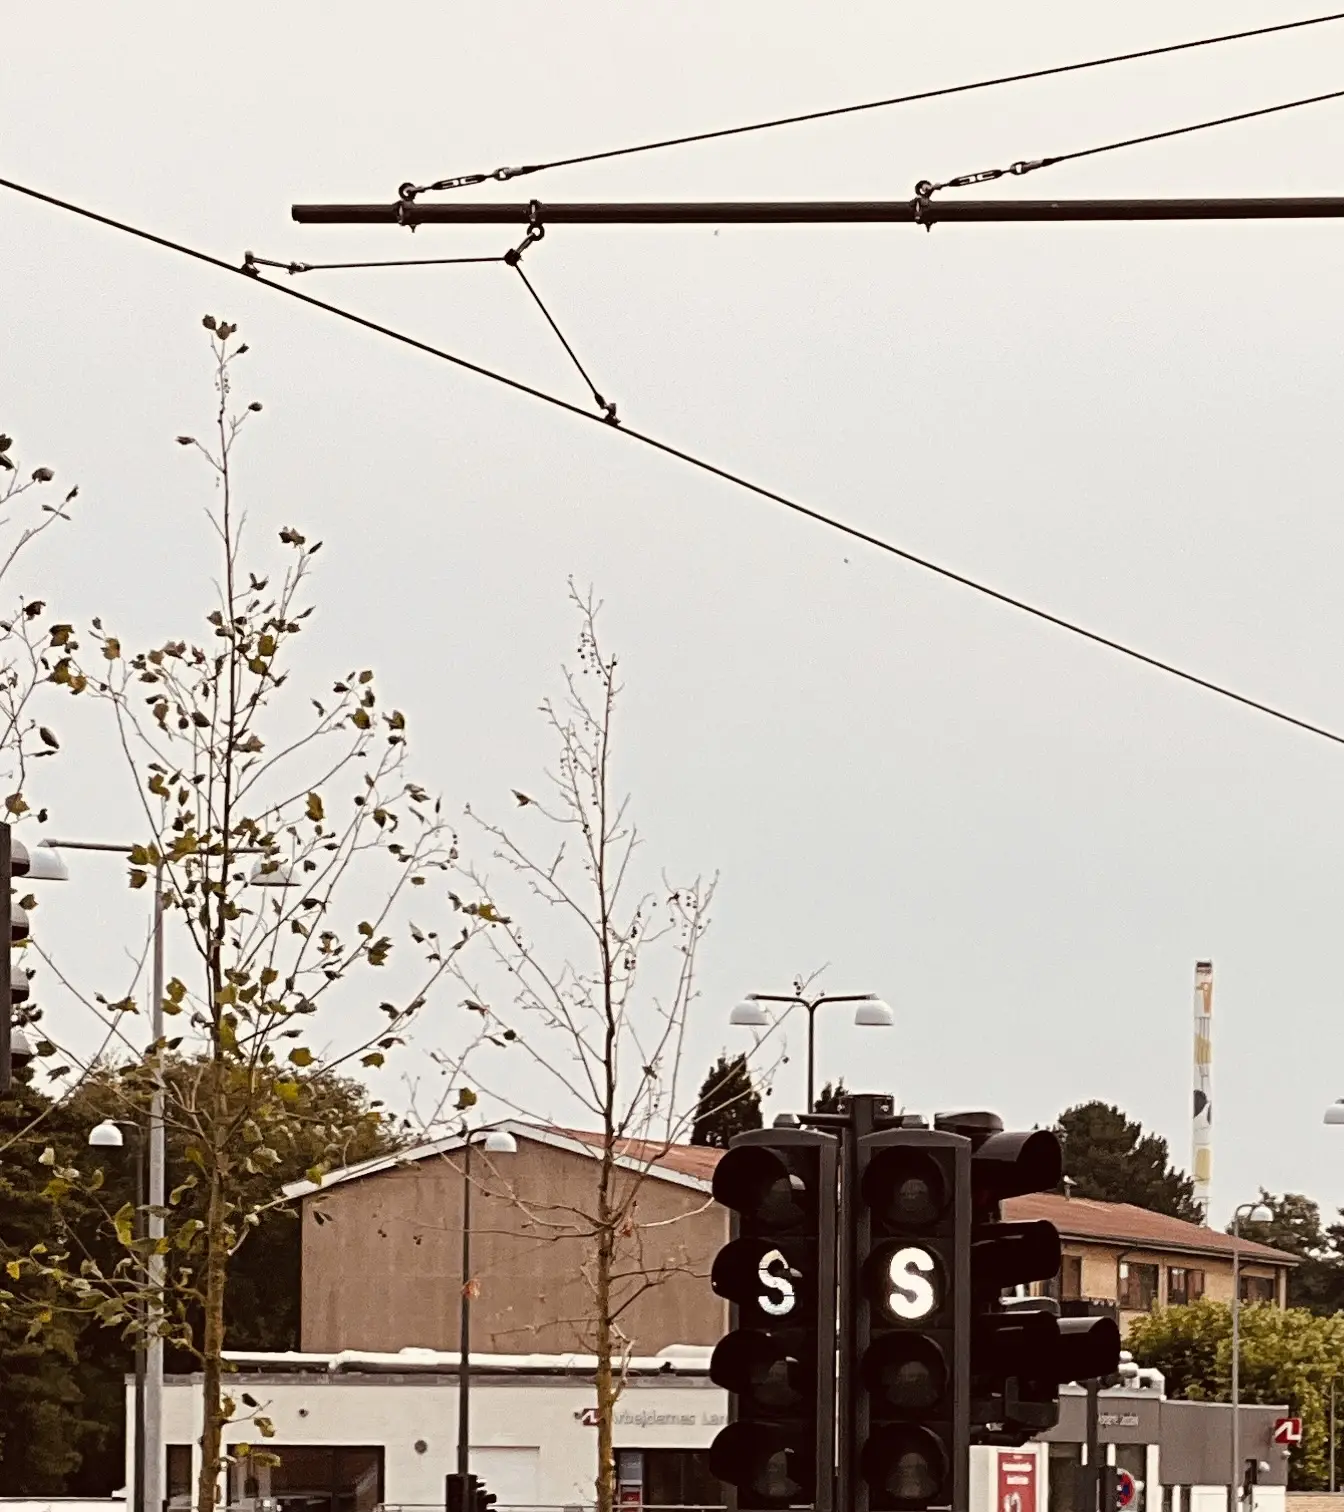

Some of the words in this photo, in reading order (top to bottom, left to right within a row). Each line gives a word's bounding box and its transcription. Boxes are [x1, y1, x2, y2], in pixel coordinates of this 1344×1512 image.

[758, 1249, 796, 1316] S
[889, 1246, 935, 1319] S
[614, 1410, 696, 1428] rbejdernes
